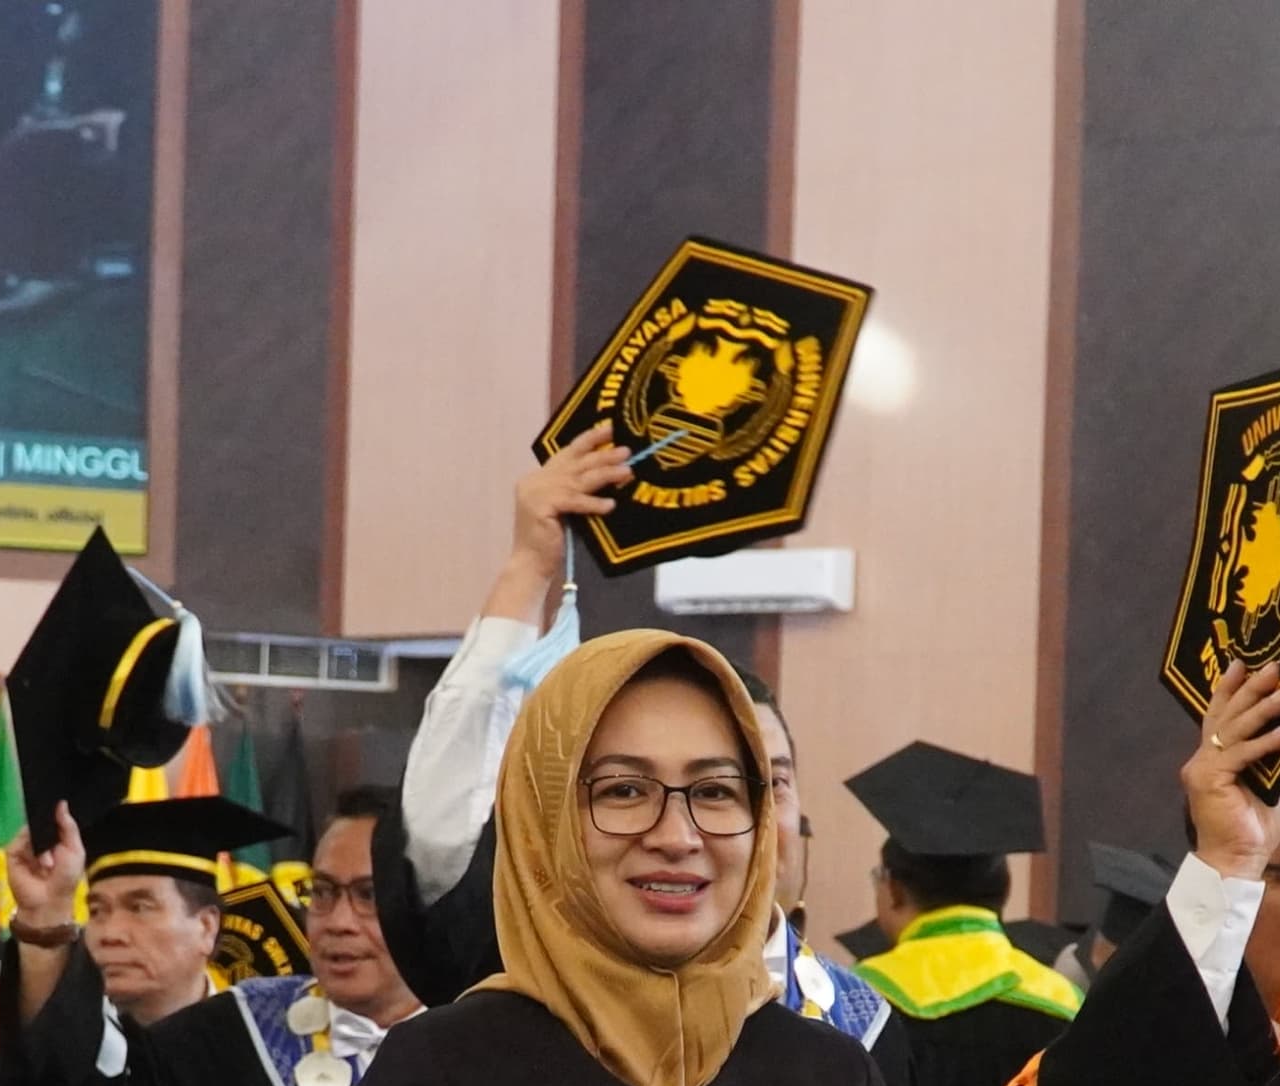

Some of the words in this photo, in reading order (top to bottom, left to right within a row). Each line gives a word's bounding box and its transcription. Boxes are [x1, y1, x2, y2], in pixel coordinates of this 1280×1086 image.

[597, 298, 688, 411] TIRTAYASA
[733, 336, 822, 487] UNIVERSITAS
[632, 480, 727, 508] SULTAN
